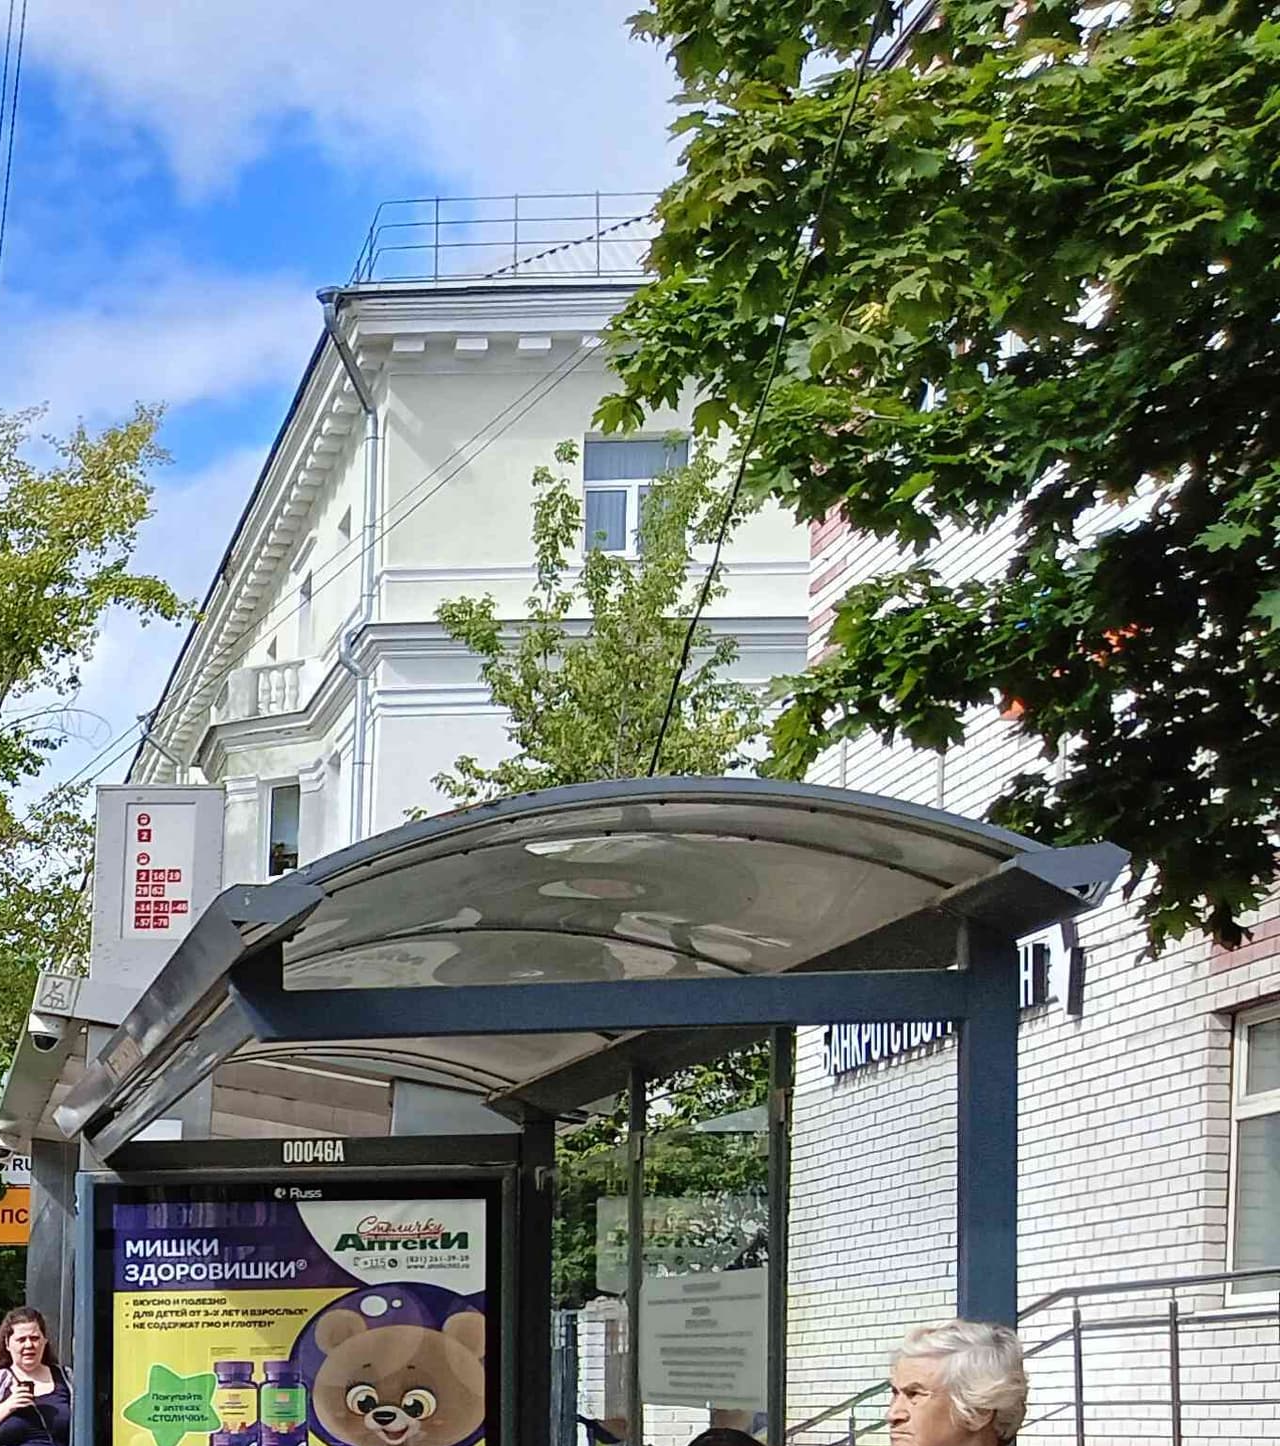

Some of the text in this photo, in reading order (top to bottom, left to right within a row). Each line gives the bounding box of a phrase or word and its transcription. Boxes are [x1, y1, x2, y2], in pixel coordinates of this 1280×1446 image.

[283, 1140, 344, 1163] 00046A
[290, 1187, 323, 1199] Russ
[125, 1238, 219, 1258] МИШКИ
[155, 1308, 187, 1319] ДЕТЕЙ
[188, 1309, 201, 1317] ОТ
[221, 1309, 240, 1317] ЛЕТ
[132, 1321, 146, 1330] НЕ
